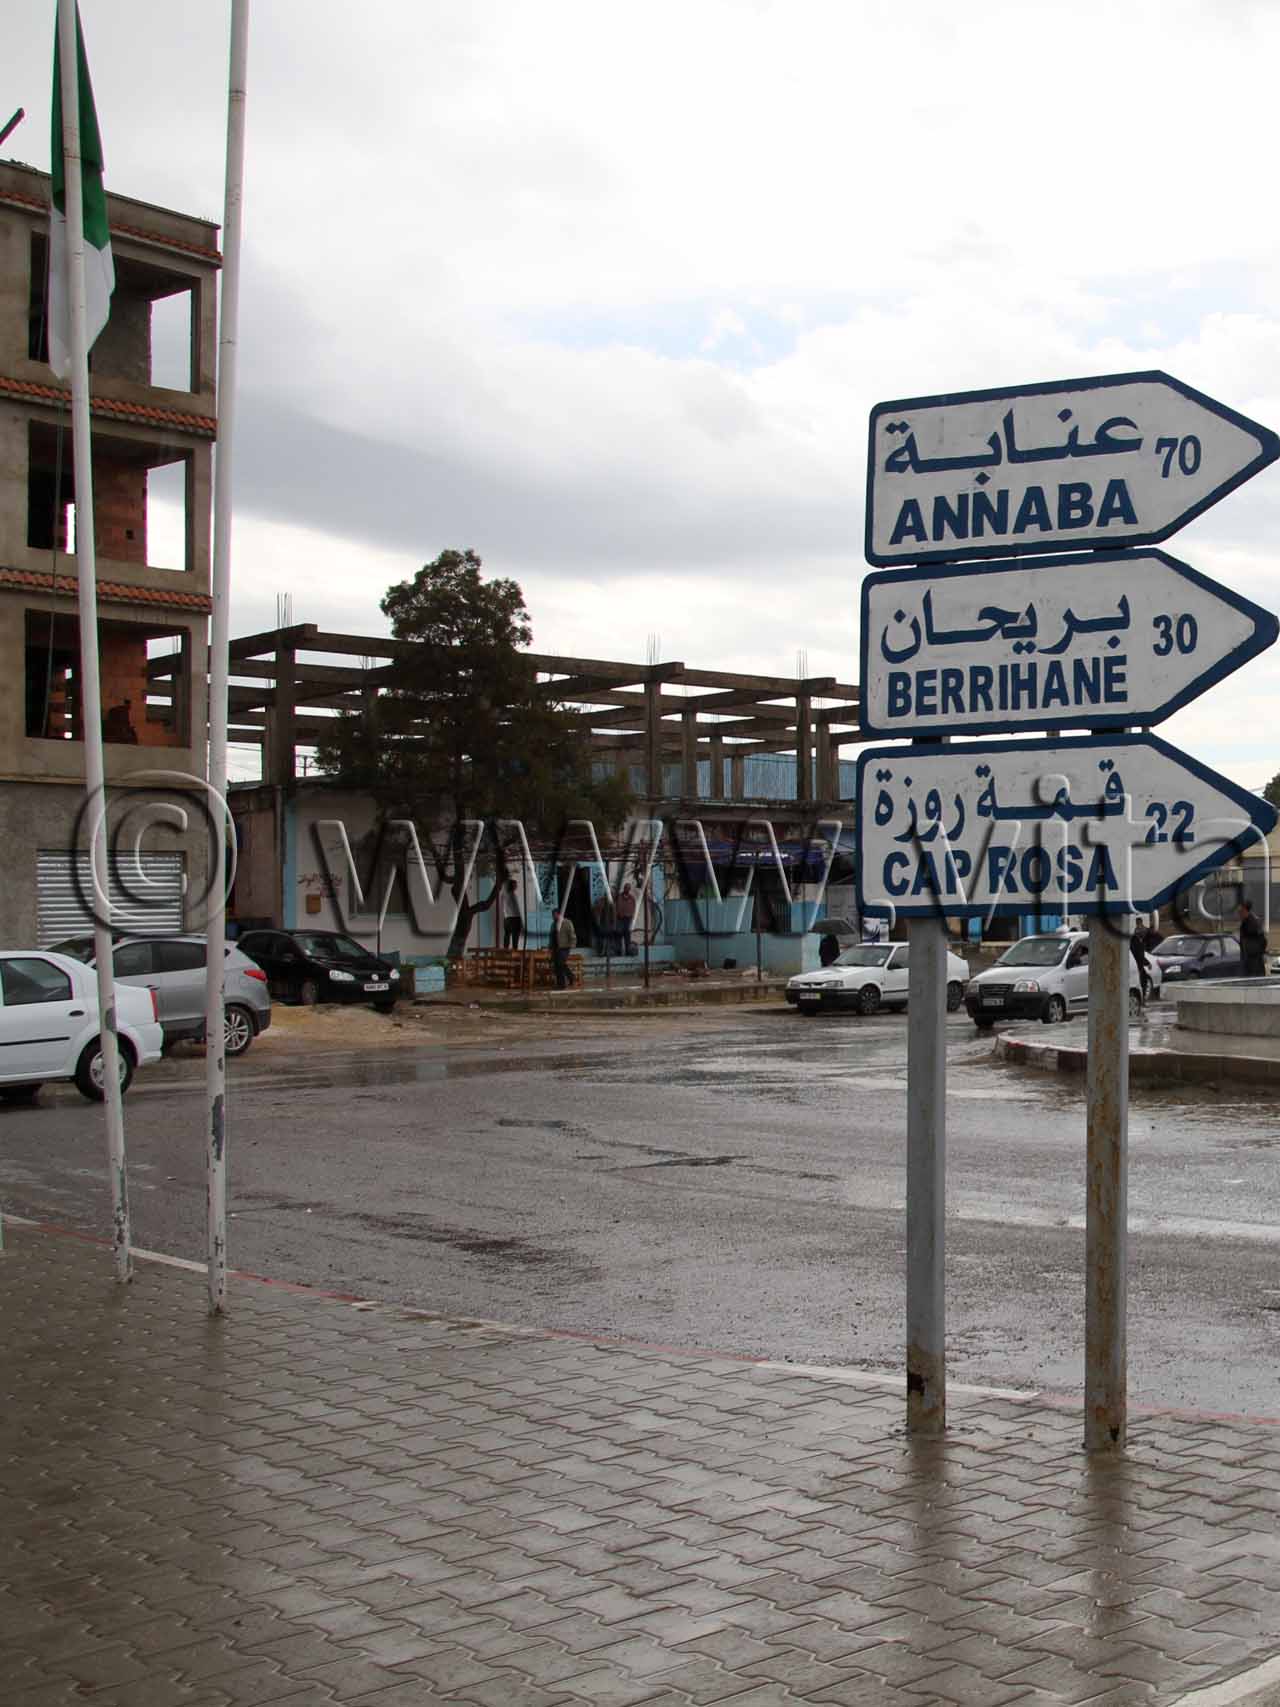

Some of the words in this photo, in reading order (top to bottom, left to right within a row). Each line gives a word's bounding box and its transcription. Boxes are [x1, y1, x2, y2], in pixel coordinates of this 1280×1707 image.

[885, 408, 1143, 485] عنابة
[1154, 434, 1202, 478] 70
[889, 479, 1138, 545] ANNABA
[880, 588, 1132, 664] بريحان
[1152, 613, 1199, 657] 30
[887, 655, 1128, 718] BERRIHANE
[874, 768, 966, 842] روزة
[975, 758, 1126, 821] قمة
[1145, 802, 1196, 843] 22
[882, 848, 972, 897] CAP
[987, 842, 1120, 891] ROSA
